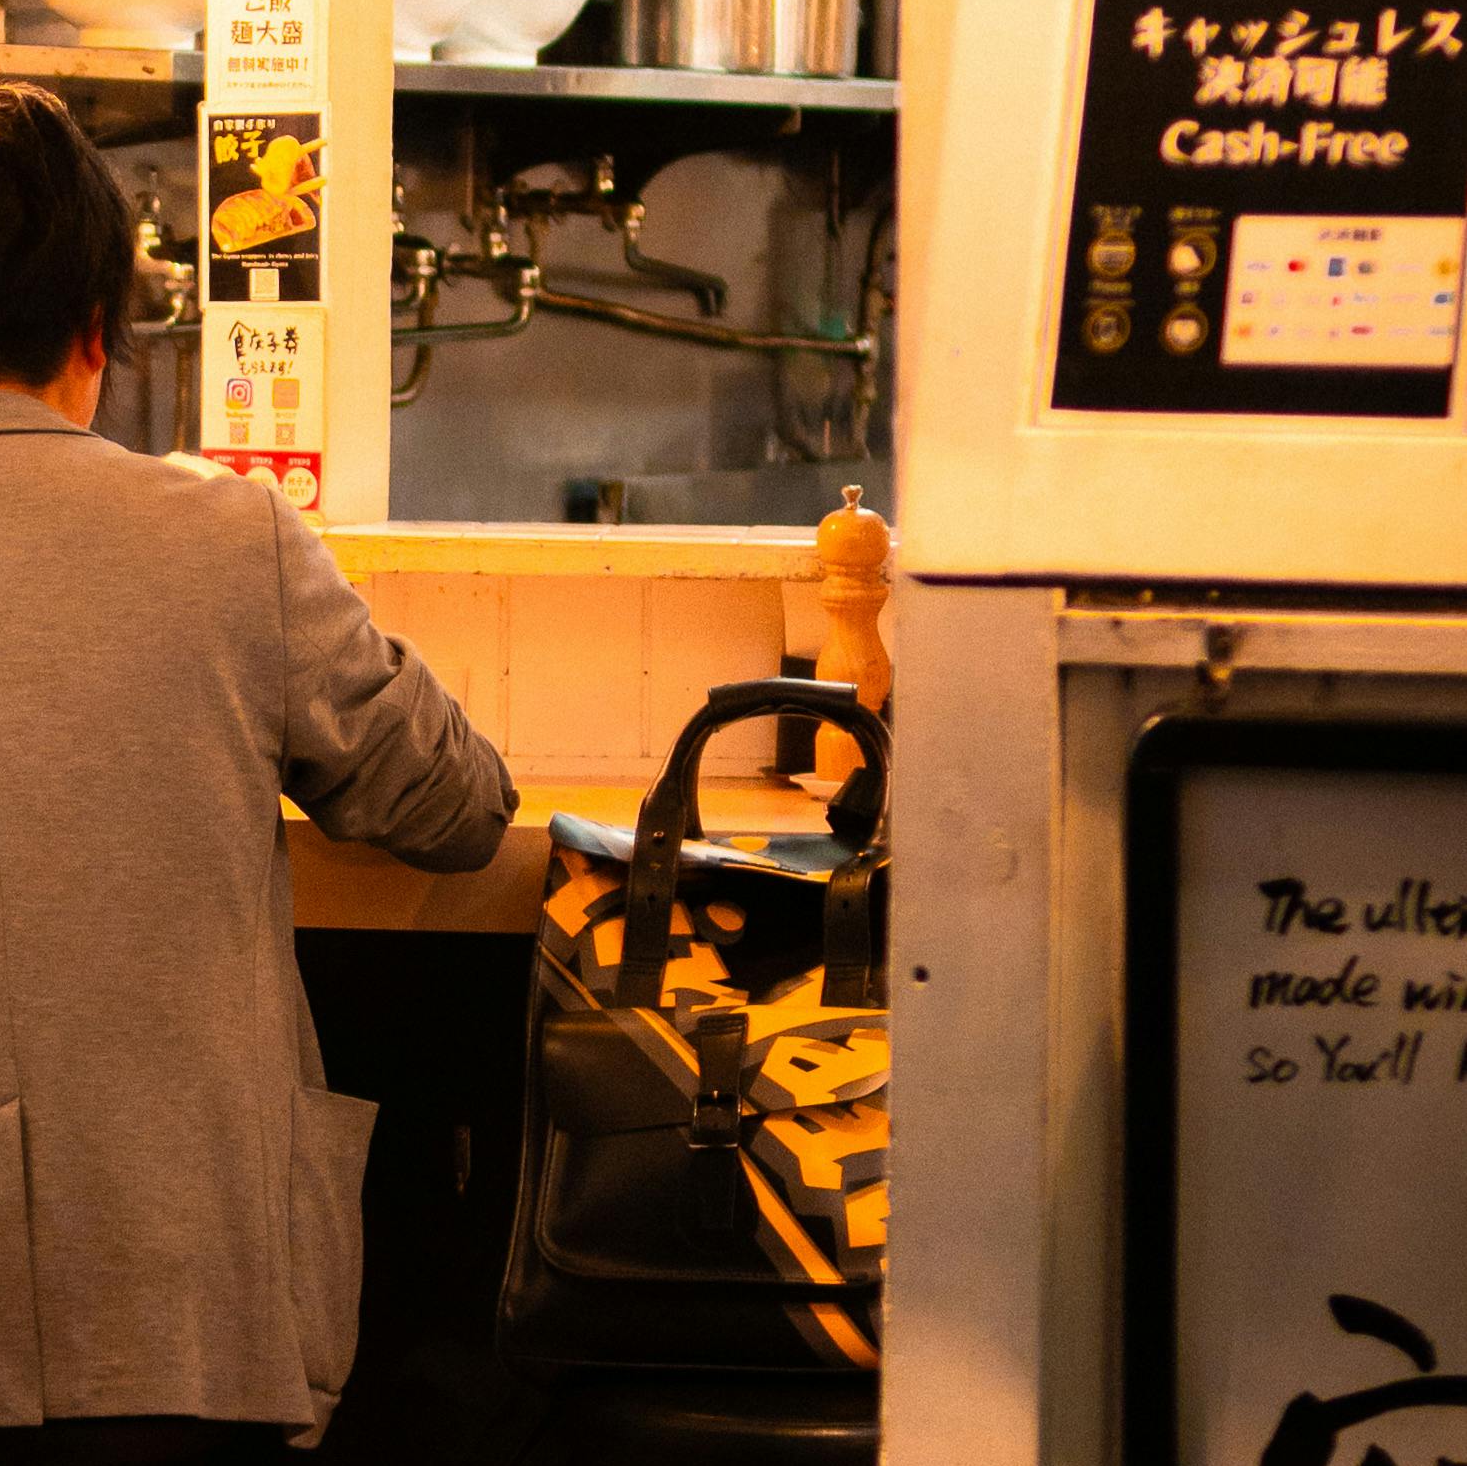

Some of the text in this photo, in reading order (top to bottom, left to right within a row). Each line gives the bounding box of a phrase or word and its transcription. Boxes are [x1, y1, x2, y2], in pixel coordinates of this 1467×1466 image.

[231, 20, 303, 45] 麺大盛
[1133, 6, 1463, 60] キャッシュレス
[214, 130, 266, 164] 餃子
[1160, 120, 1409, 166] Cash-Free
[1258, 877, 1350, 935] The
[1249, 955, 1381, 1010] made
